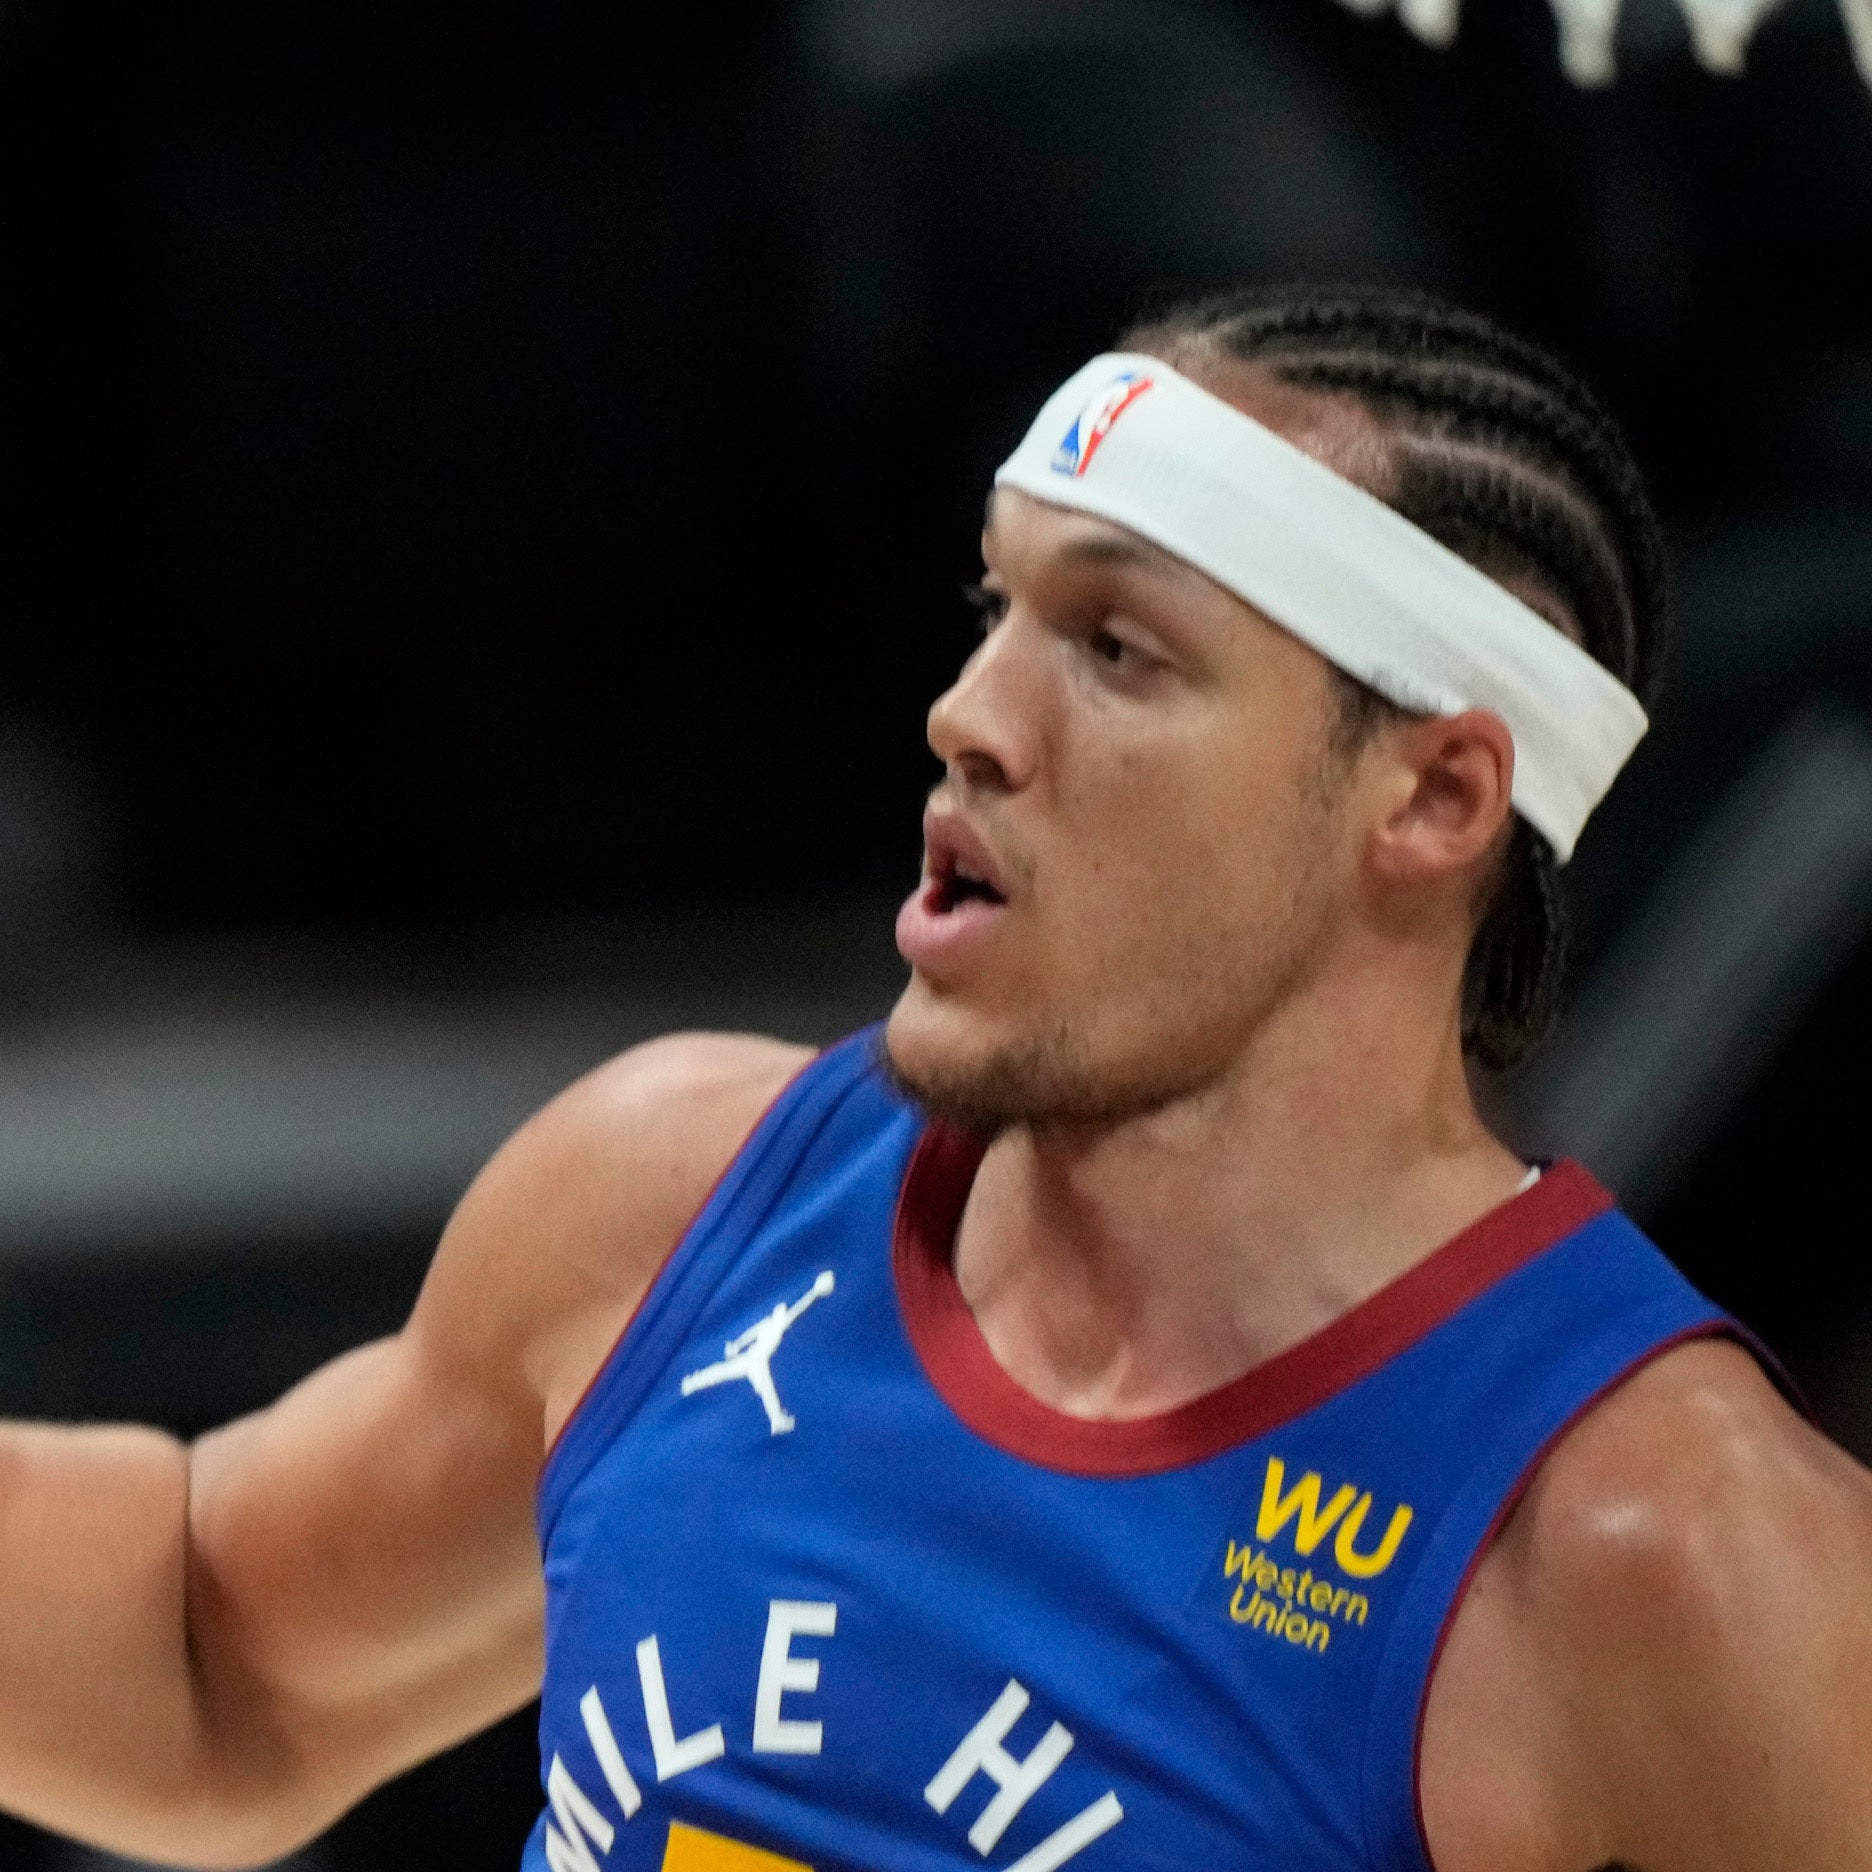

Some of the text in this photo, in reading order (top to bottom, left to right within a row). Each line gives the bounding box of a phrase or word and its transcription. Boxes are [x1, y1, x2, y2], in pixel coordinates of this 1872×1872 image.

[1255, 1455, 1414, 1579] WU
[1224, 1539, 1369, 1627] Western
[1229, 1584, 1331, 1653] Union
